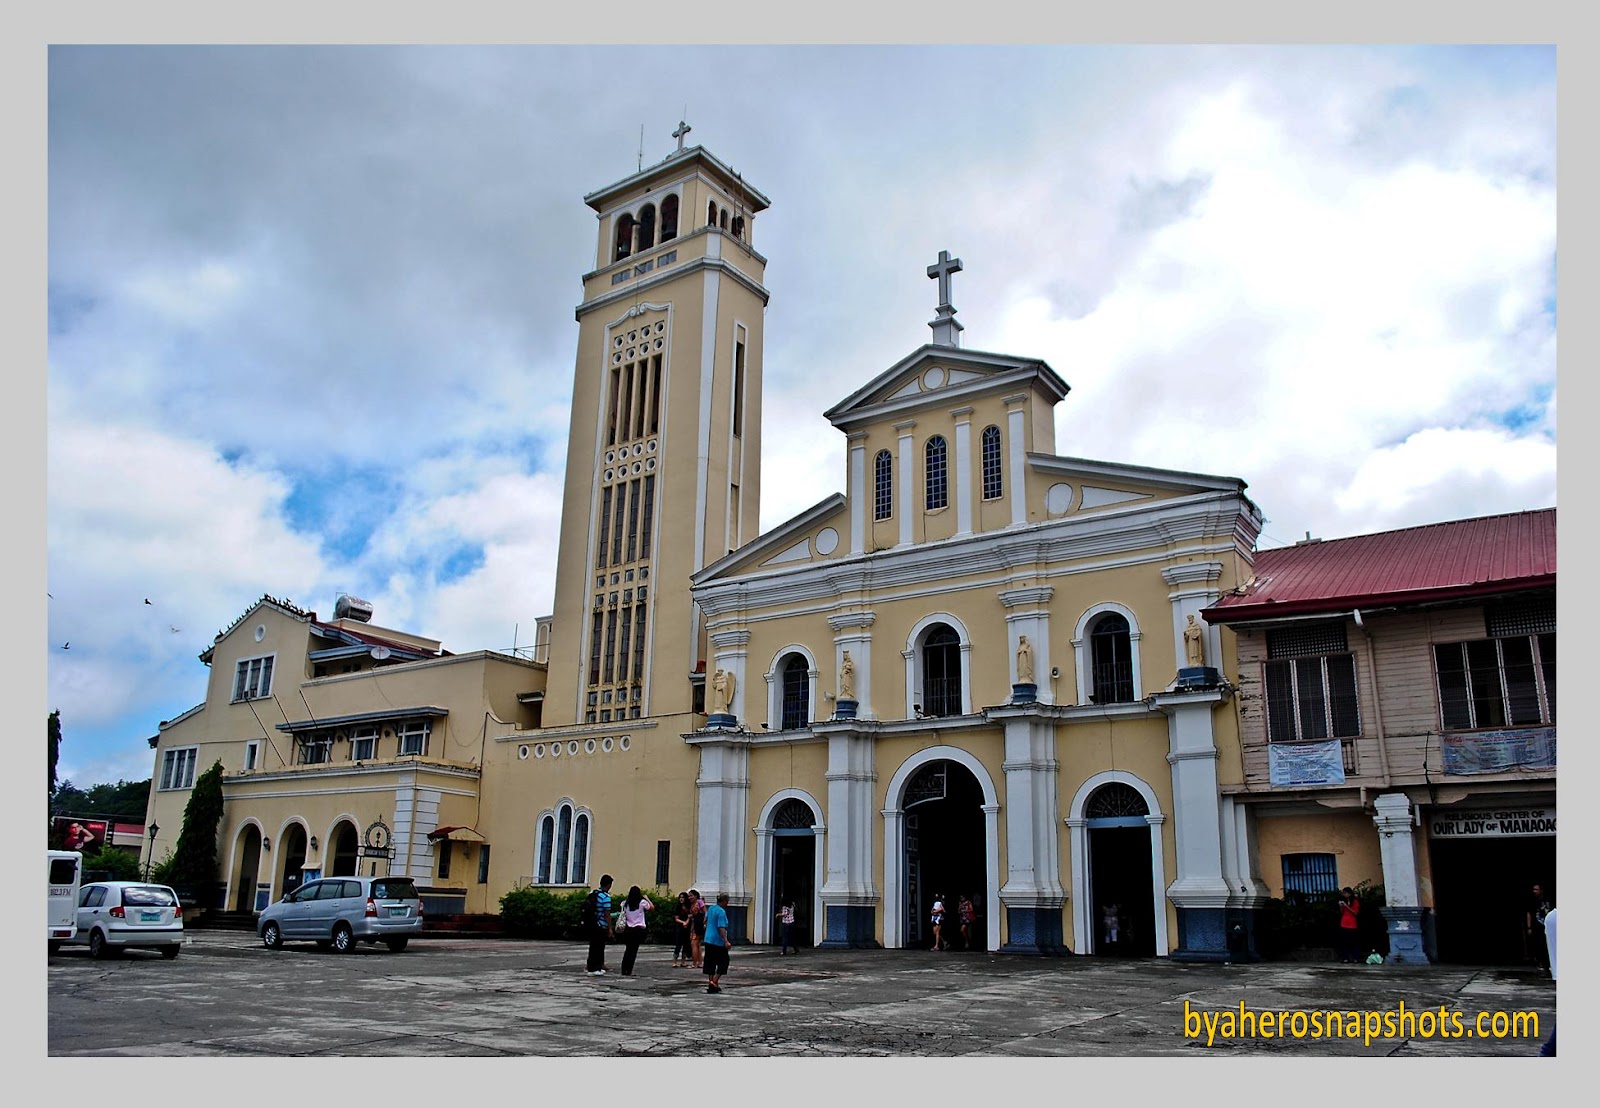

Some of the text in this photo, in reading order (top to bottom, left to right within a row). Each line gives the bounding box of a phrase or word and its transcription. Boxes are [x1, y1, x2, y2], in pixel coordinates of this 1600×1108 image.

[1444, 810, 1545, 821] RELIGIOUS CENTER OF
[1433, 821, 1455, 835] OUR
[1455, 820, 1486, 835] LADY
[1486, 823, 1498, 831] OF
